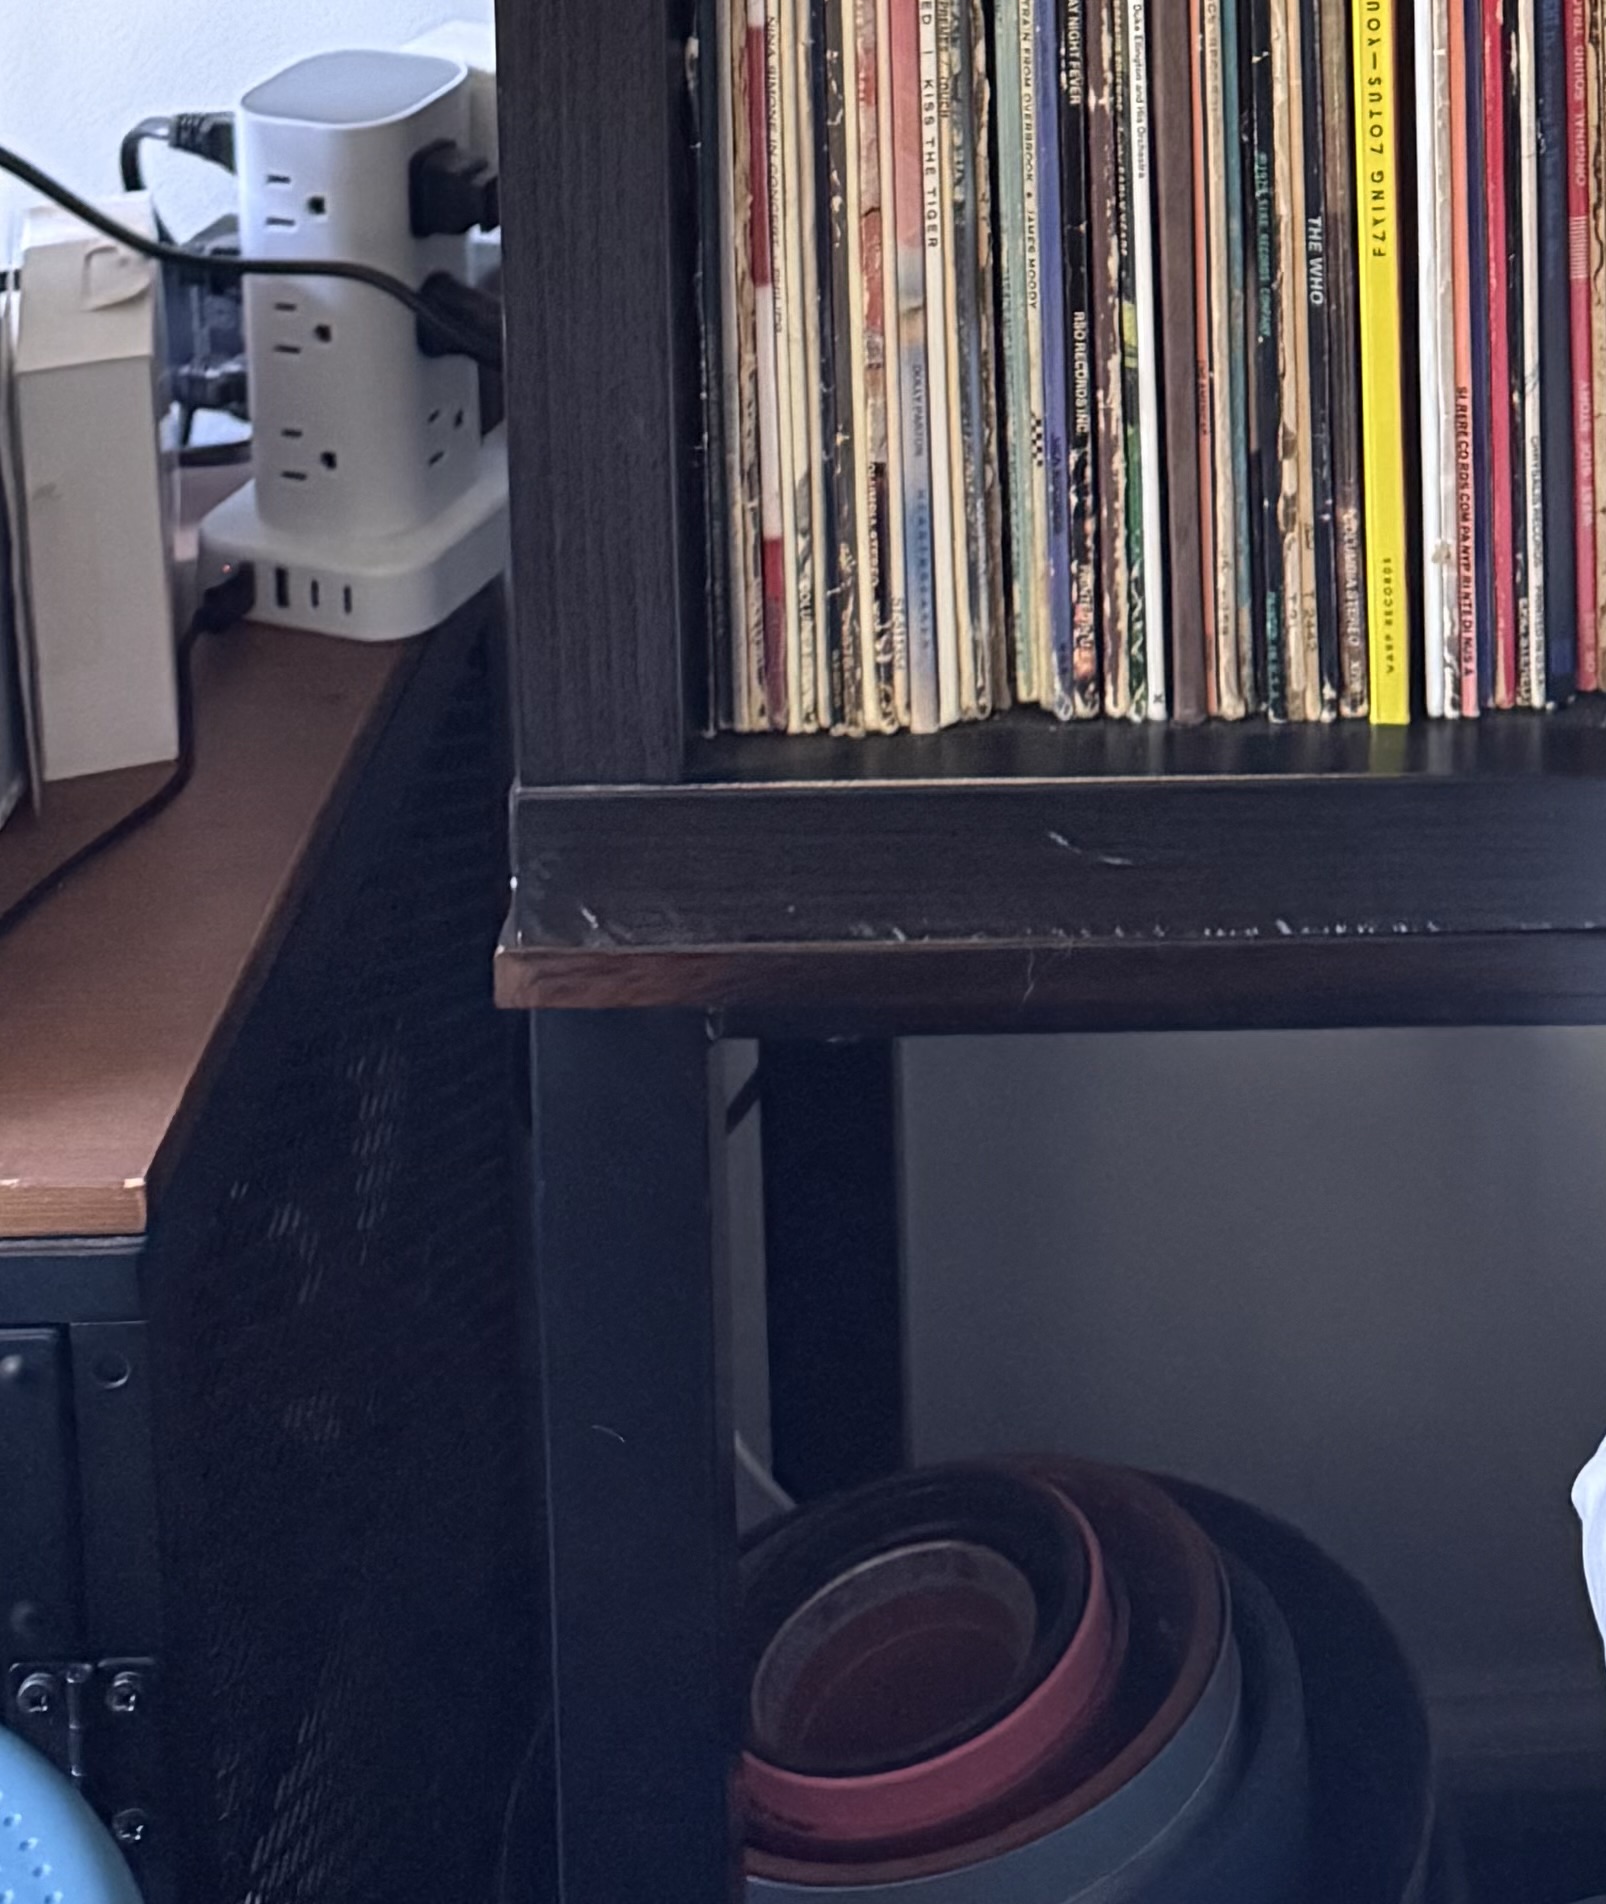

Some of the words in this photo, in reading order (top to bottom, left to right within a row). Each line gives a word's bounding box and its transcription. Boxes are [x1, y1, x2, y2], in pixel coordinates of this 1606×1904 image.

[1067, 17, 1080, 58] NIGHT
[1131, 4, 1142, 31] Duke
[1133, 35, 1144, 80] Ellington
[1574, 46, 1584, 101] SOUND
[923, 79, 934, 126] KISS
[1068, 62, 1081, 104] FEVER
[1135, 85, 1144, 103] and
[1136, 107, 1146, 123] His
[925, 138, 936, 176] THE
[1137, 127, 1148, 179] Orchestra
[1574, 112, 1586, 186] ORIGINAL
[926, 188, 938, 248] TIGER
[1307, 216, 1321, 251] THE
[1371, 172, 1386, 257] FLYING
[1308, 257, 1323, 304] WHO
